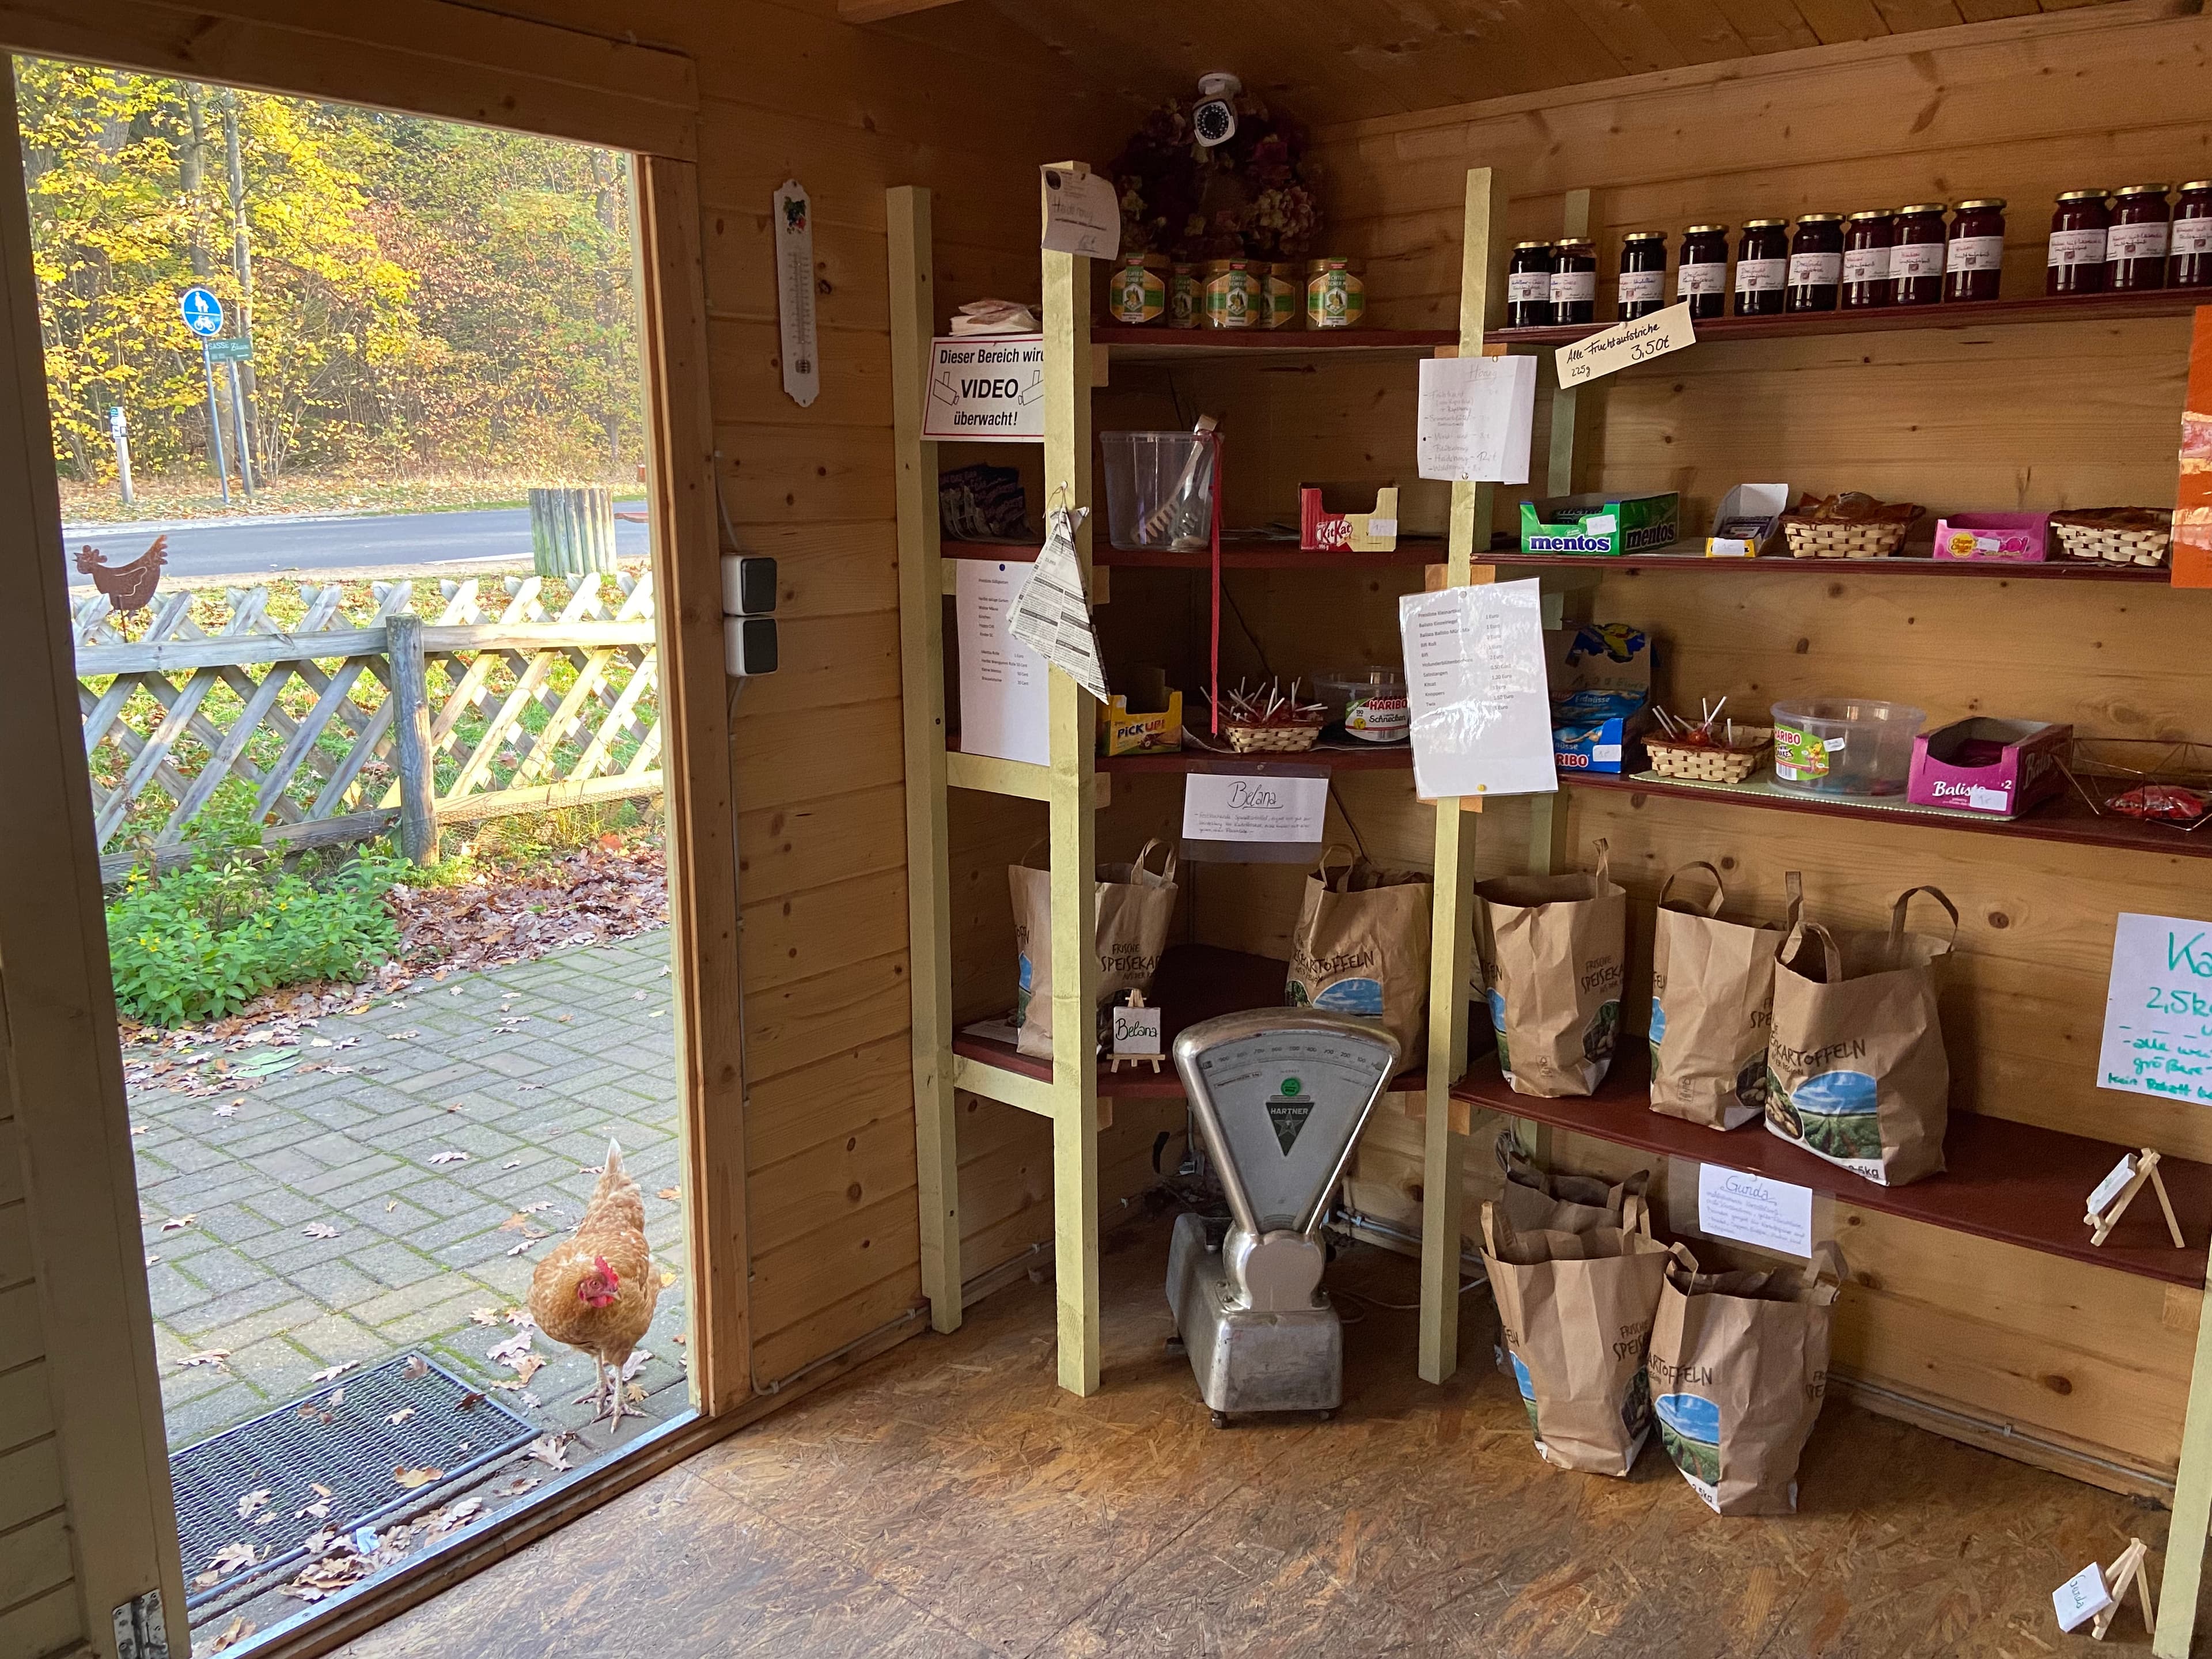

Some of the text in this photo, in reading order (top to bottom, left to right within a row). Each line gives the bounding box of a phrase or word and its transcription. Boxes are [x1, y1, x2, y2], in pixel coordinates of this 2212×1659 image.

[1567, 323, 1660, 363] Alle Fruchtaufstriche
[940, 350, 975, 363] Dieser
[978, 349, 1019, 363] Bereich
[1571, 365, 1590, 377] 225g
[961, 379, 1018, 398] VIDEO
[1320, 520, 1351, 544] KitKat
[1626, 522, 1675, 548] mentos
[1531, 536, 1610, 551] mentos
[1369, 698, 1407, 710] HARIBO
[1575, 695, 1611, 703] Erdnüsse
[1369, 714, 1406, 723] Schnecken
[1554, 740, 1579, 750] nüsse
[1556, 753, 1588, 767] RIBO
[1227, 781, 1277, 808] Belana
[1112, 944, 1141, 955] FRISCHE
[2146, 986, 2212, 1017] 2,5k
[1116, 1018, 1158, 1040] Belana
[1725, 1175, 1771, 1200] Gunda
[1648, 1354, 1713, 1385] ARTOFFELN
[2070, 1574, 2087, 1609] Gunda
